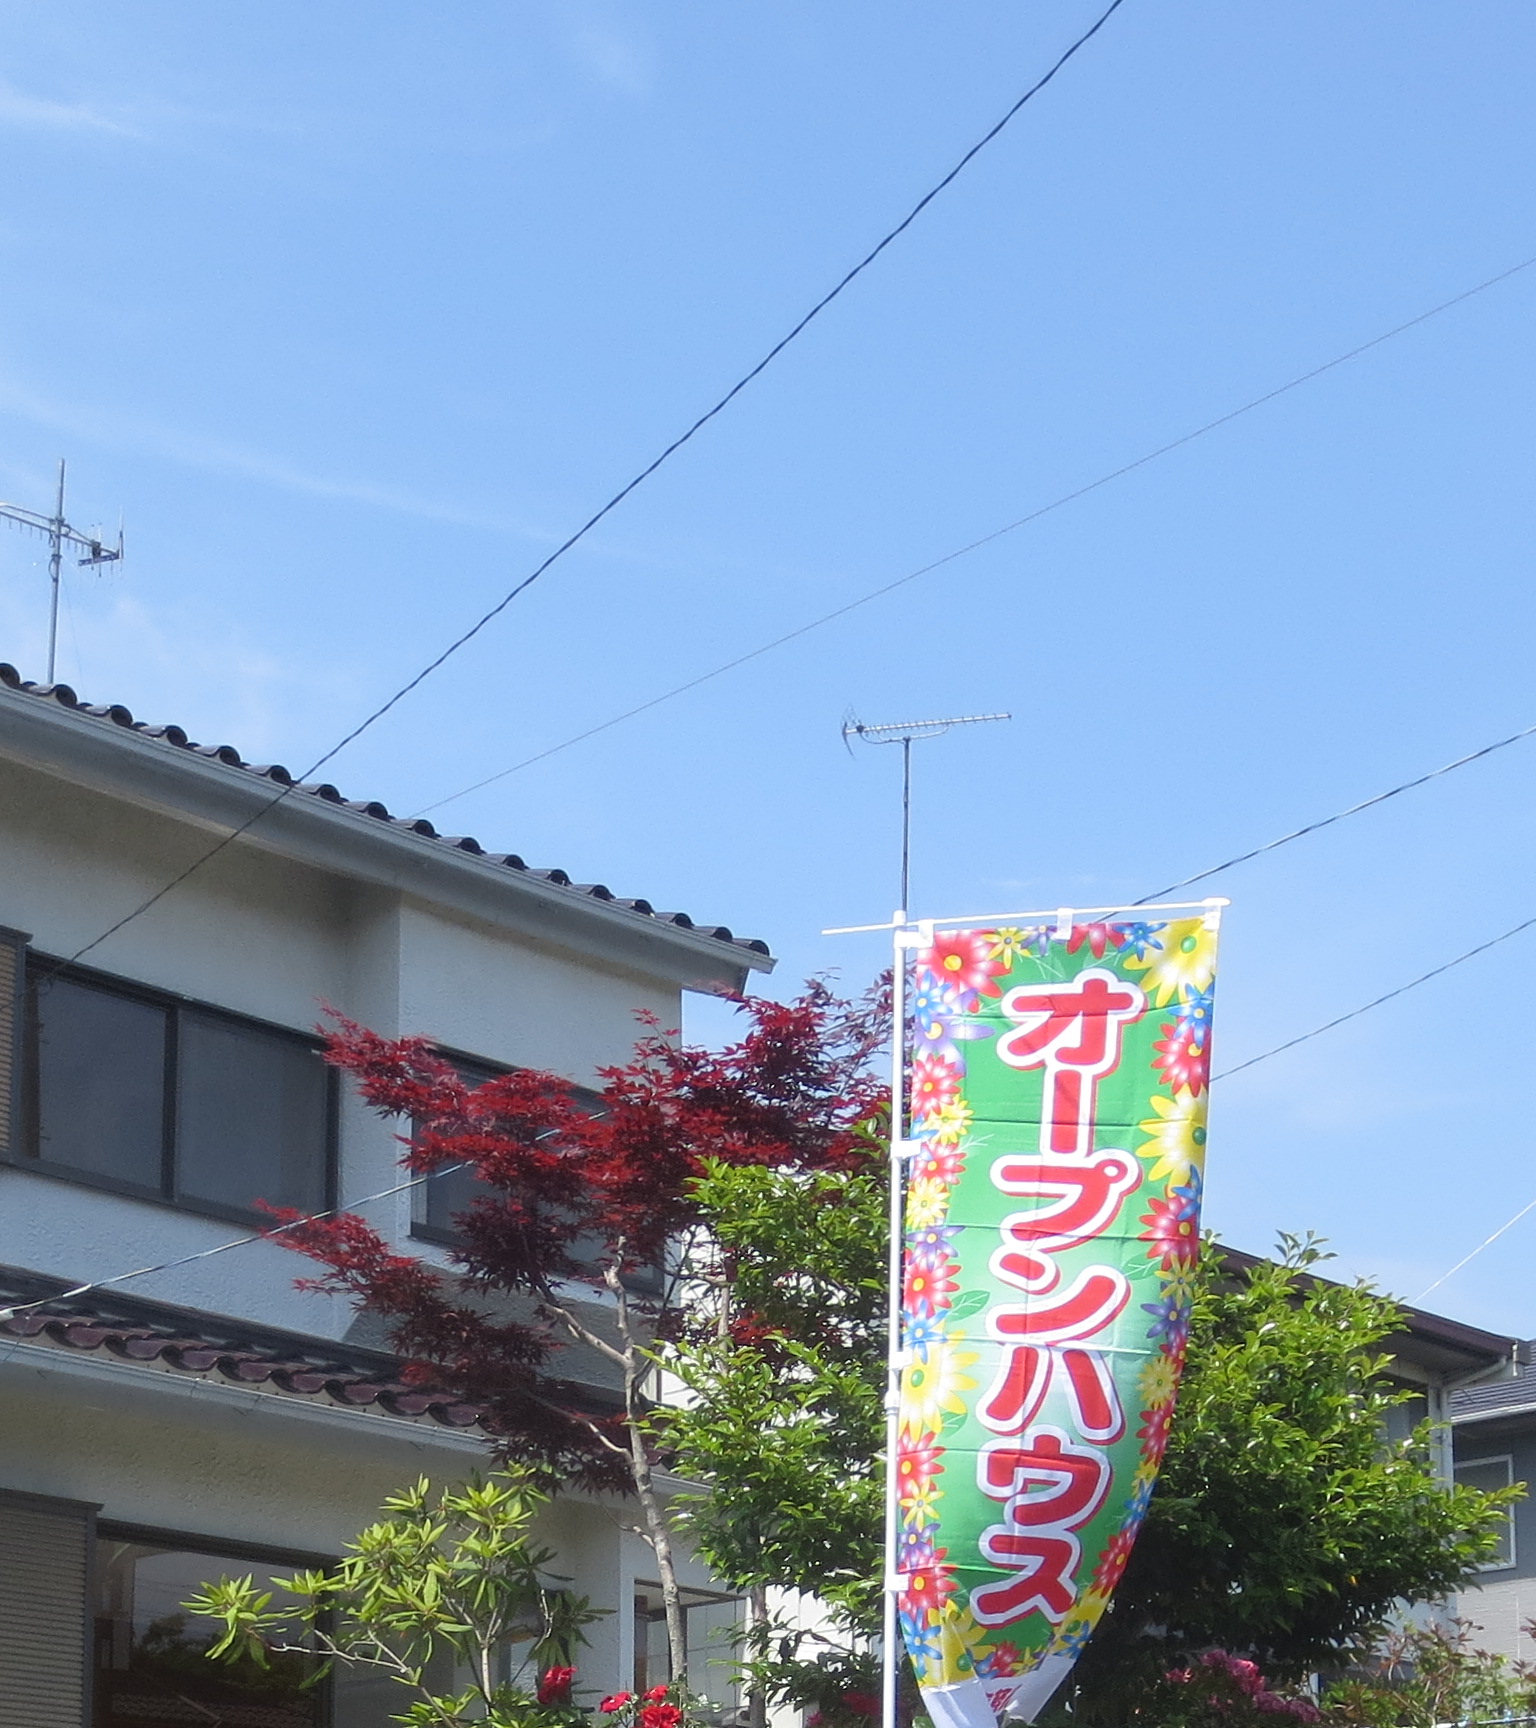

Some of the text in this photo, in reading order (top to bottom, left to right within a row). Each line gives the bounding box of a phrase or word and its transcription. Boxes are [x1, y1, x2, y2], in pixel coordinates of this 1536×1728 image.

[972, 968, 1146, 1630] オープンハウス
